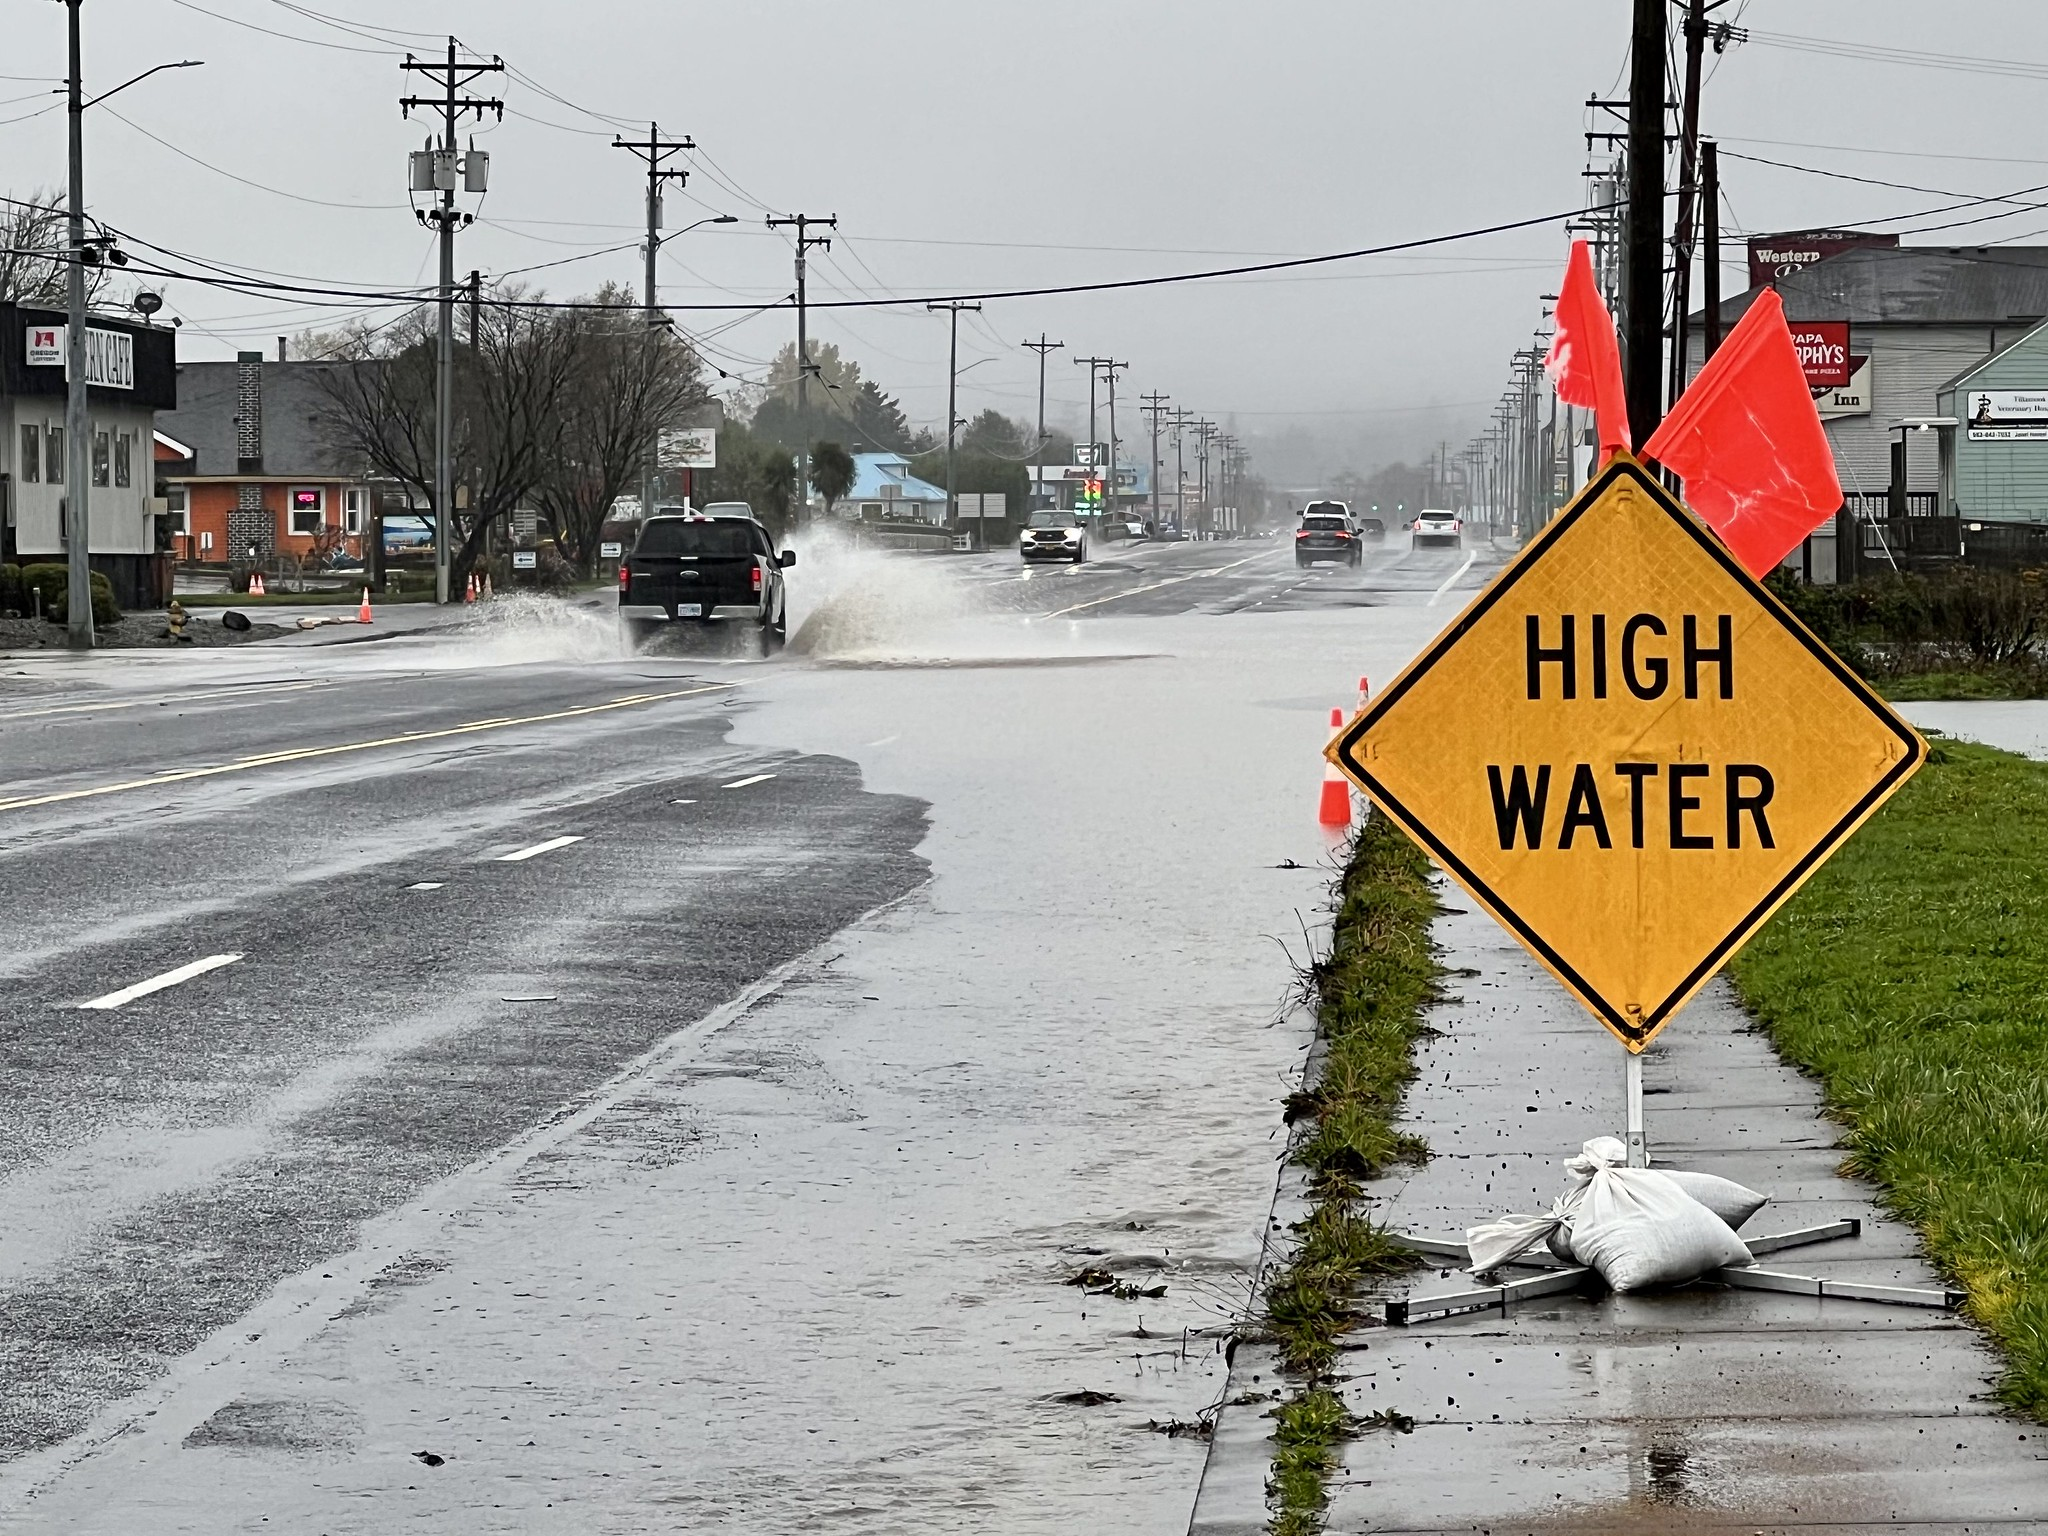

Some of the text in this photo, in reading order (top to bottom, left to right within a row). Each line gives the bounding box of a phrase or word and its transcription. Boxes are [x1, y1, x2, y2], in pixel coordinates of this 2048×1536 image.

[1756, 249, 1820, 263] Western
[106, 333, 131, 385] CAFE
[1796, 344, 1844, 366] PHY'S
[1833, 393, 1860, 406] Inn
[1526, 614, 1734, 701] HIGH
[1487, 763, 1776, 850] WATER
